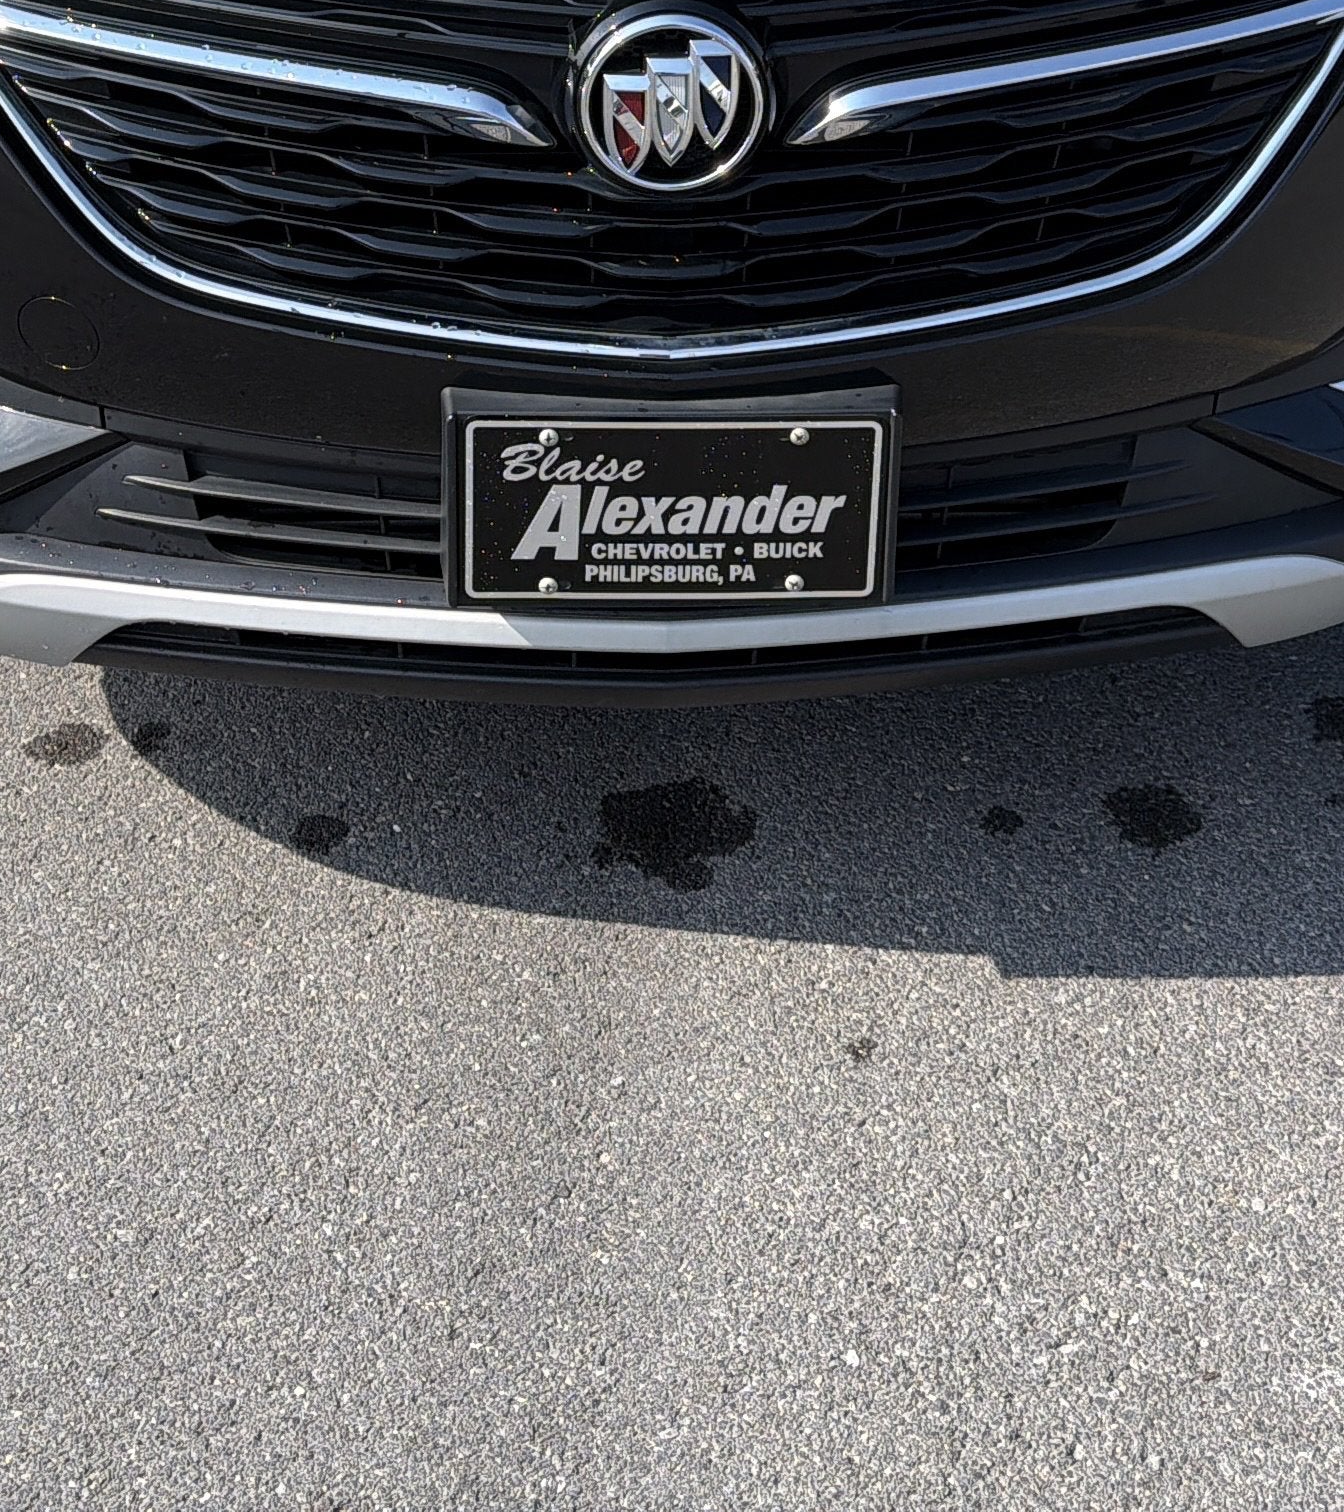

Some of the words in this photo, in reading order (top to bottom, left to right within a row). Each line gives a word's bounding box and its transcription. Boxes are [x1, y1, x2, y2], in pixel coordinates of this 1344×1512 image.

[500, 443, 646, 483] Blaise
[510, 484, 847, 561] Alexander
[591, 542, 726, 560] CHEVROLET
[753, 541, 824, 559] BUICK
[584, 564, 725, 586] PHILIPSBURG,
[728, 564, 757, 583] PA
